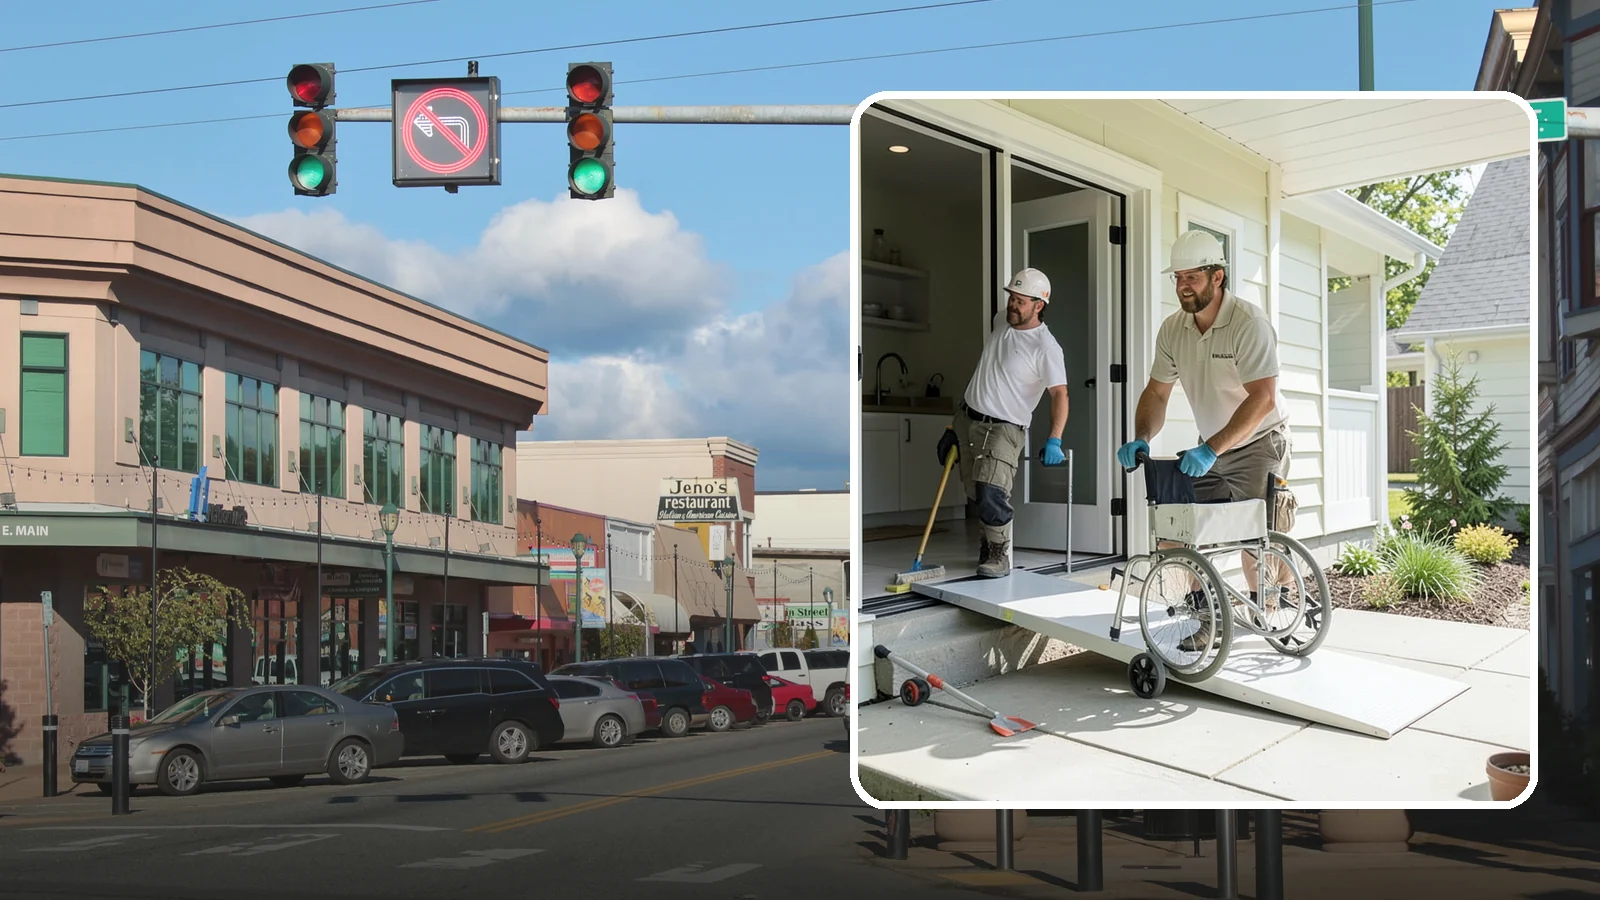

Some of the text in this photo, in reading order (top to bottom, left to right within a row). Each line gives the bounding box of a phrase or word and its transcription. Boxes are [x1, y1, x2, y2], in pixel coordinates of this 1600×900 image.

[669, 480, 727, 494] Jeno's
[665, 496, 731, 509] restaurant
[659, 510, 681, 519] Italian
[686, 510, 714, 519] American
[715, 510, 737, 519] Cuisine
[2, 525, 49, 536] E. MAIN
[797, 607, 828, 617] Street
